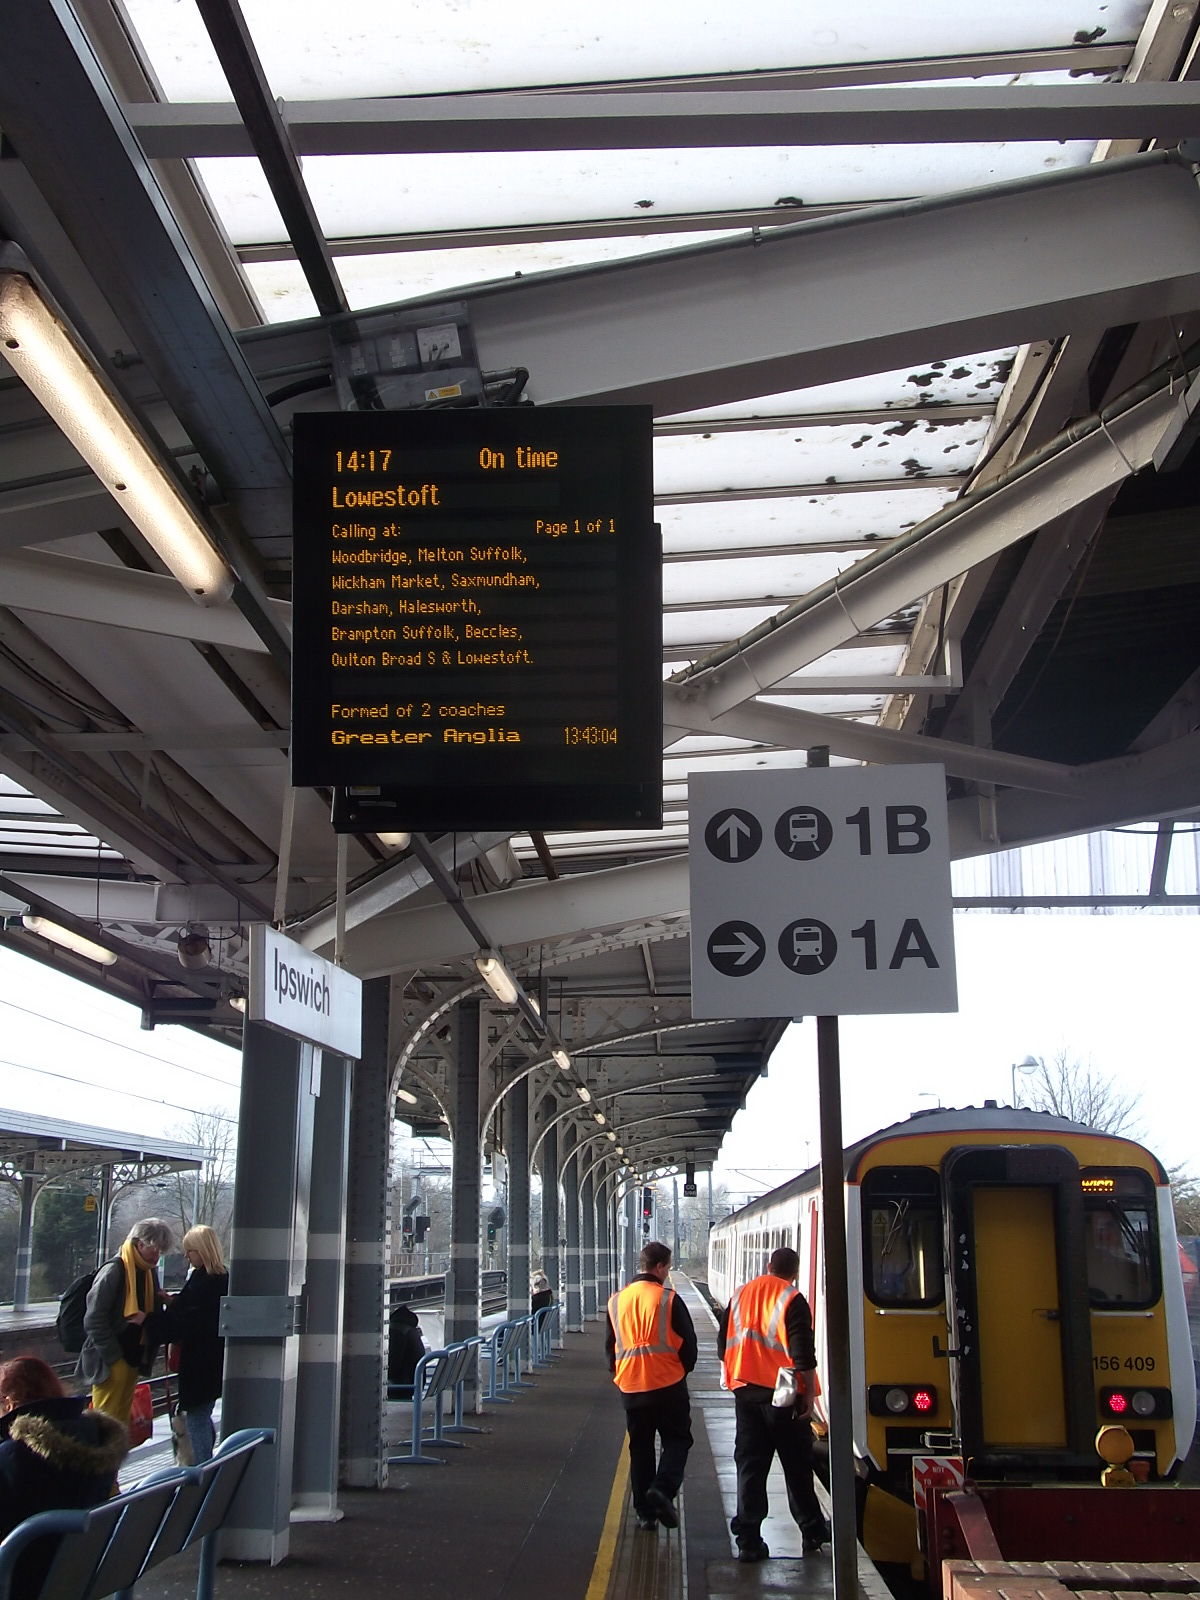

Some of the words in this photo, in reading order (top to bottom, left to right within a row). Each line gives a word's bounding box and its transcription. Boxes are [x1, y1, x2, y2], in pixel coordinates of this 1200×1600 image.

[335, 449, 392, 473] 14:17
[479, 447, 505, 469] On
[515, 446, 558, 468] time
[332, 484, 440, 508] Lowestoft
[332, 523, 376, 541] Calling
[382, 522, 401, 537] at:
[536, 519, 568, 536] Page
[574, 519, 581, 534] 1
[586, 518, 603, 533] of
[609, 518, 615, 533] 1
[332, 548, 412, 566] Woodbridge,
[418, 547, 464, 562] Melton
[470, 546, 528, 563] Suffolk,
[332, 574, 385, 589] Wickham
[391, 573, 445, 589] Market,
[451, 572, 540, 589] Saxmundham,
[332, 600, 393, 617] Darsham,
[399, 598, 482, 616] Halesworth,
[331, 626, 396, 644] Brampton
[402, 624, 460, 642] Suffolk,
[465, 624, 524, 641] Beccles,
[331, 652, 376, 667] Oulton
[381, 651, 421, 666] Broad
[427, 651, 435, 665] S
[441, 650, 451, 665] &
[457, 649, 534, 665] Lowestoft.
[331, 703, 389, 719] Formed
[396, 703, 413, 718] of
[421, 702, 431, 717] 2
[438, 702, 505, 717] coaches
[331, 729, 433, 745] Greater
[443, 728, 522, 745] Anglia
[564, 726, 618, 745] 13:43:04
[846, 804, 931, 856] 1B
[851, 918, 940, 970] 1A
[274, 947, 330, 1016] Ipswich
[1093, 1356, 1120, 1371] 156
[1124, 1356, 1155, 1371] 409
